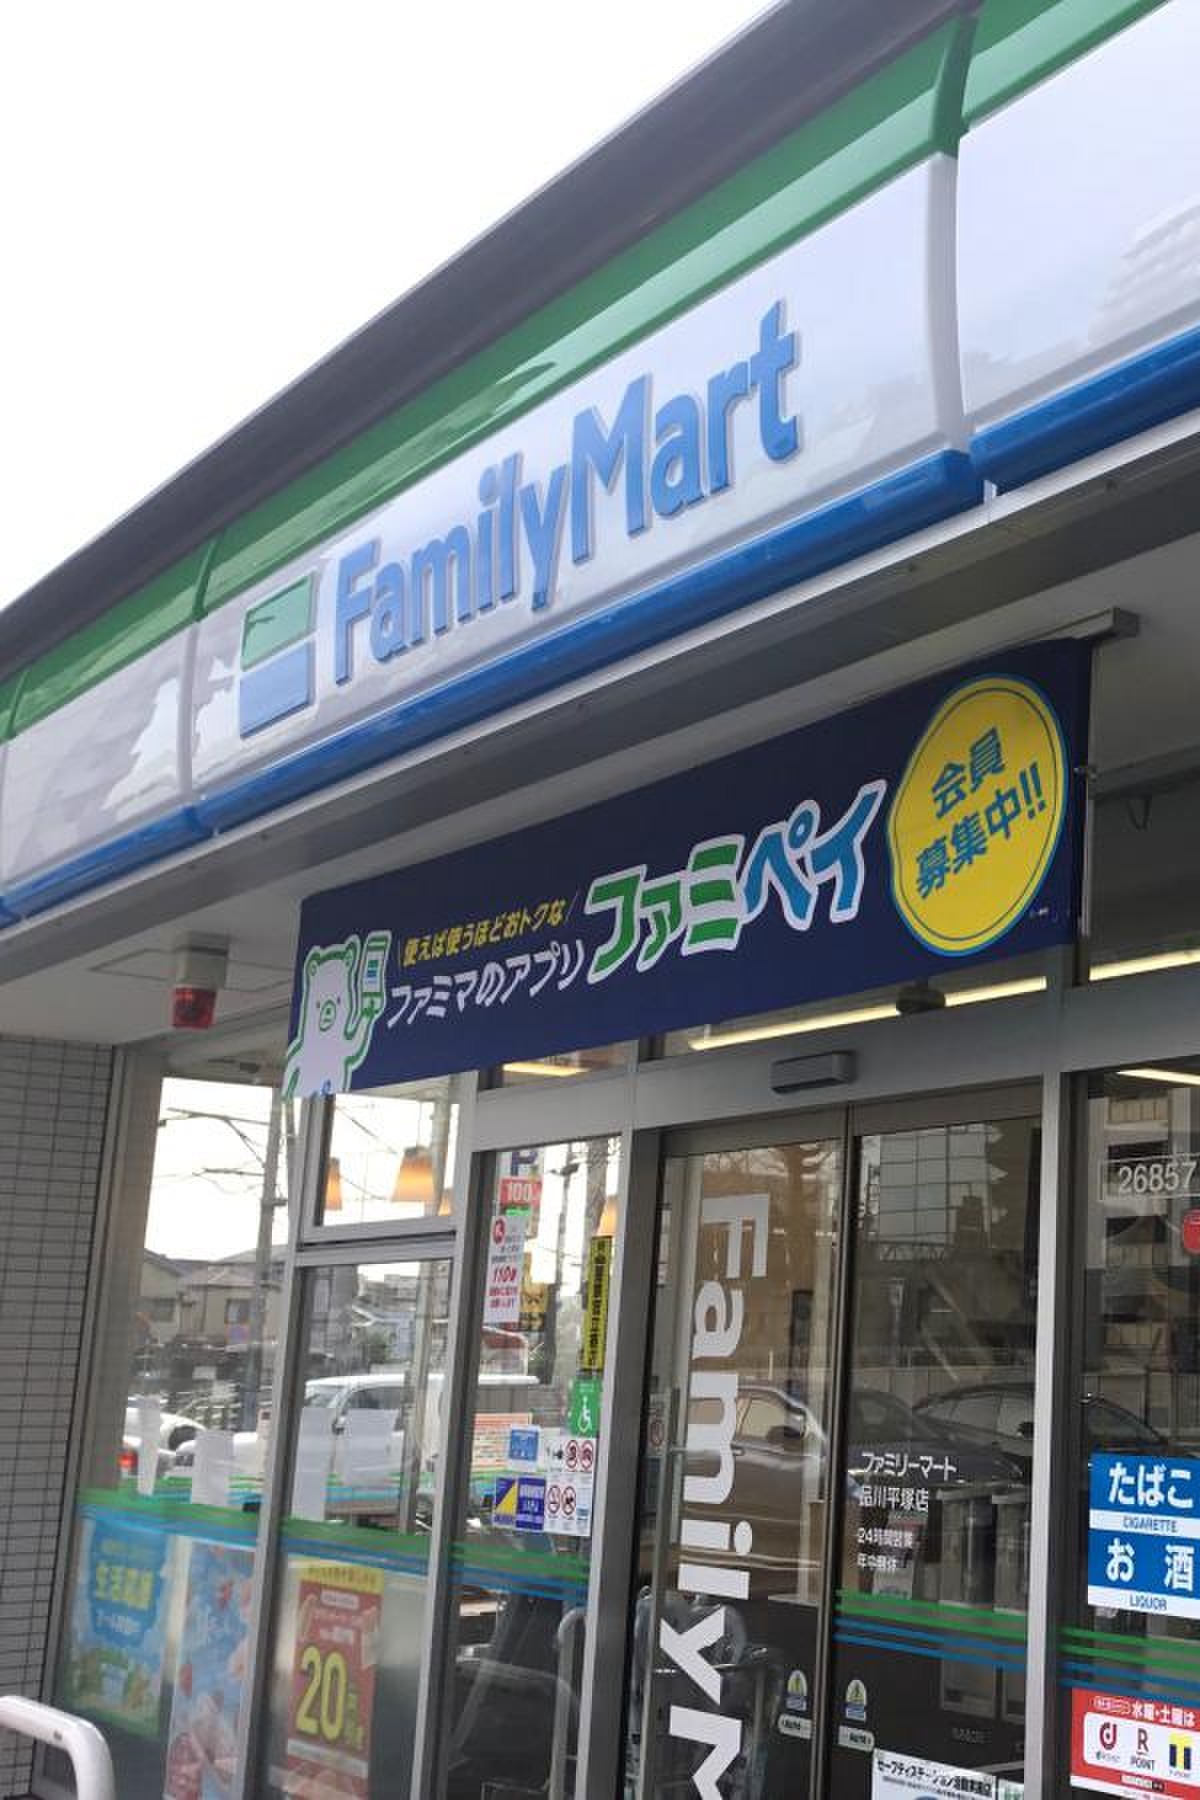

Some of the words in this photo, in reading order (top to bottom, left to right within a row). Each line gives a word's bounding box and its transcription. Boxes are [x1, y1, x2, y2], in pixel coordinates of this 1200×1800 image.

[333, 298, 802, 687] FamilyMart
[931, 726, 1006, 817] 会員
[584, 779, 888, 985] ファミペイ
[404, 898, 567, 967] 使えば使うほどおトクな
[387, 939, 586, 1029] ファミマのアプリ
[1117, 1160, 1197, 1194] 26857
[861, 1451, 957, 1482] ファミリーマート
[1108, 1461, 1194, 1509] たばこ
[1122, 1515, 1178, 1533] CIGARETTE
[1129, 1594, 1167, 1611] LIQUOR
